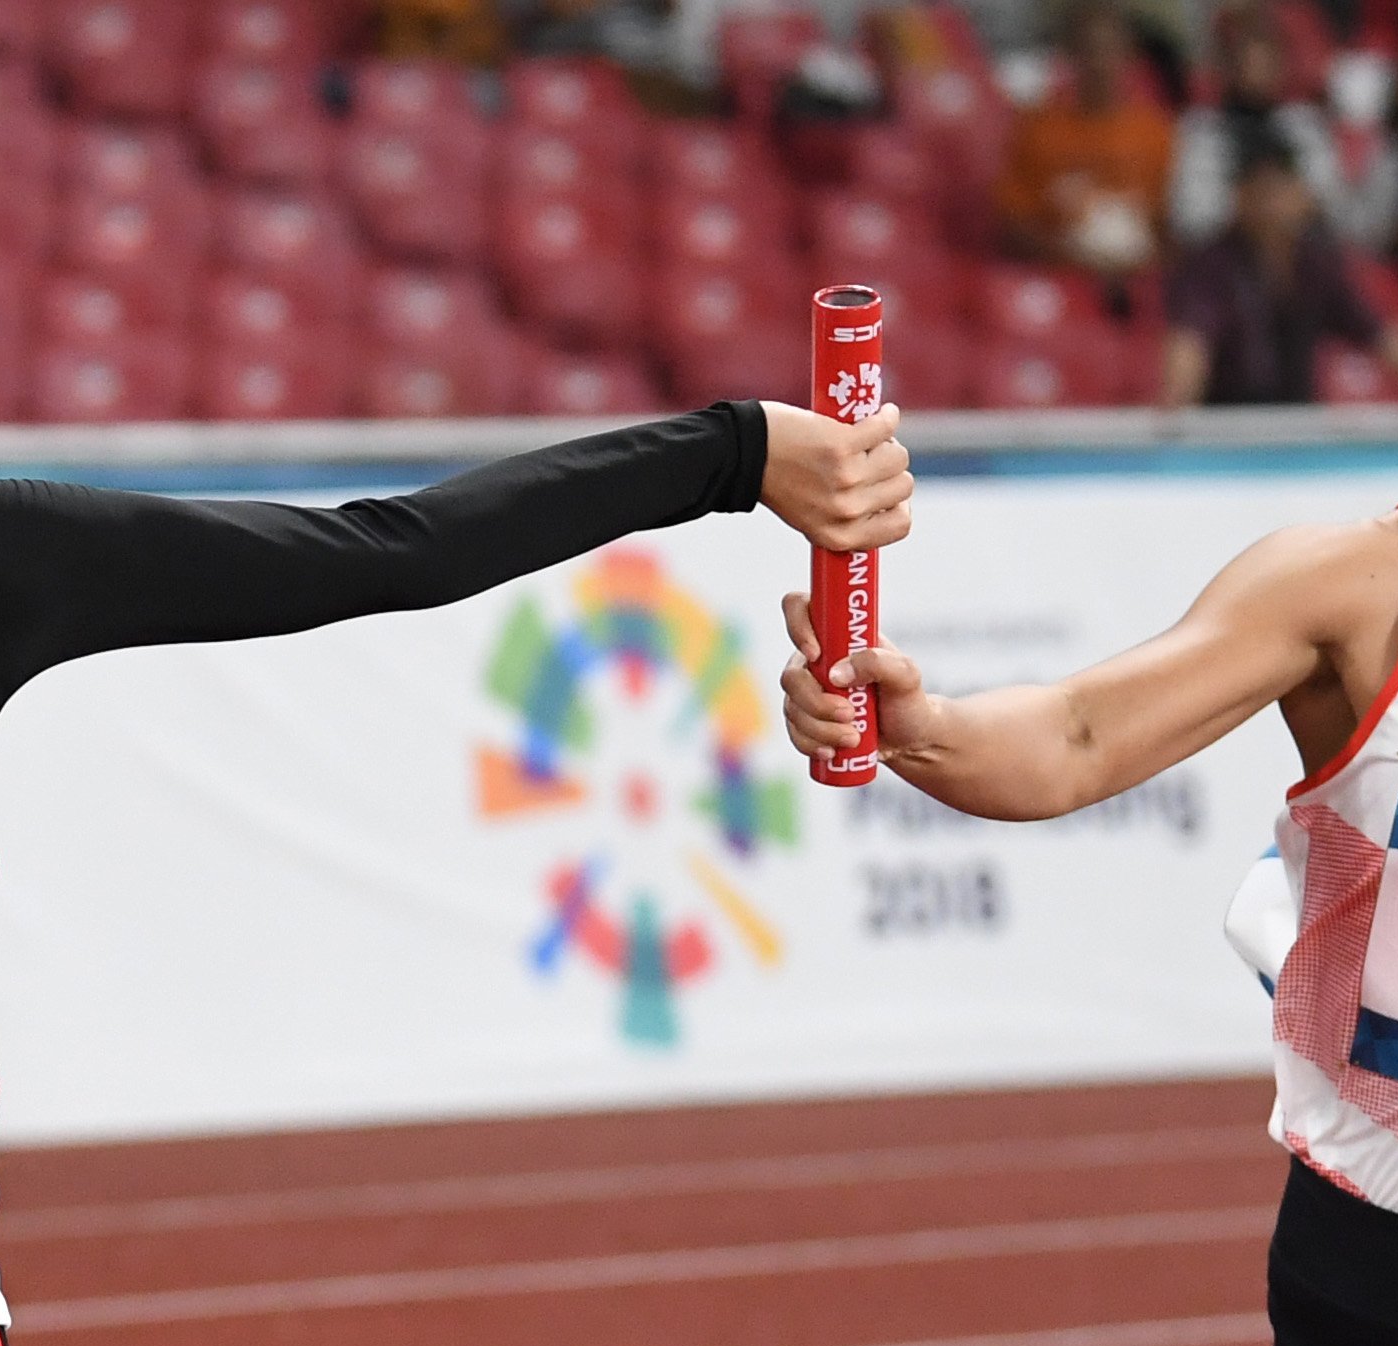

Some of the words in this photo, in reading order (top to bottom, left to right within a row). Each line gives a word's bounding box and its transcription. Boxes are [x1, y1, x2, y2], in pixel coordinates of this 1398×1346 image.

[848, 550, 868, 585] AN
[848, 589, 868, 657] GAM
[849, 684, 868, 733] 018
